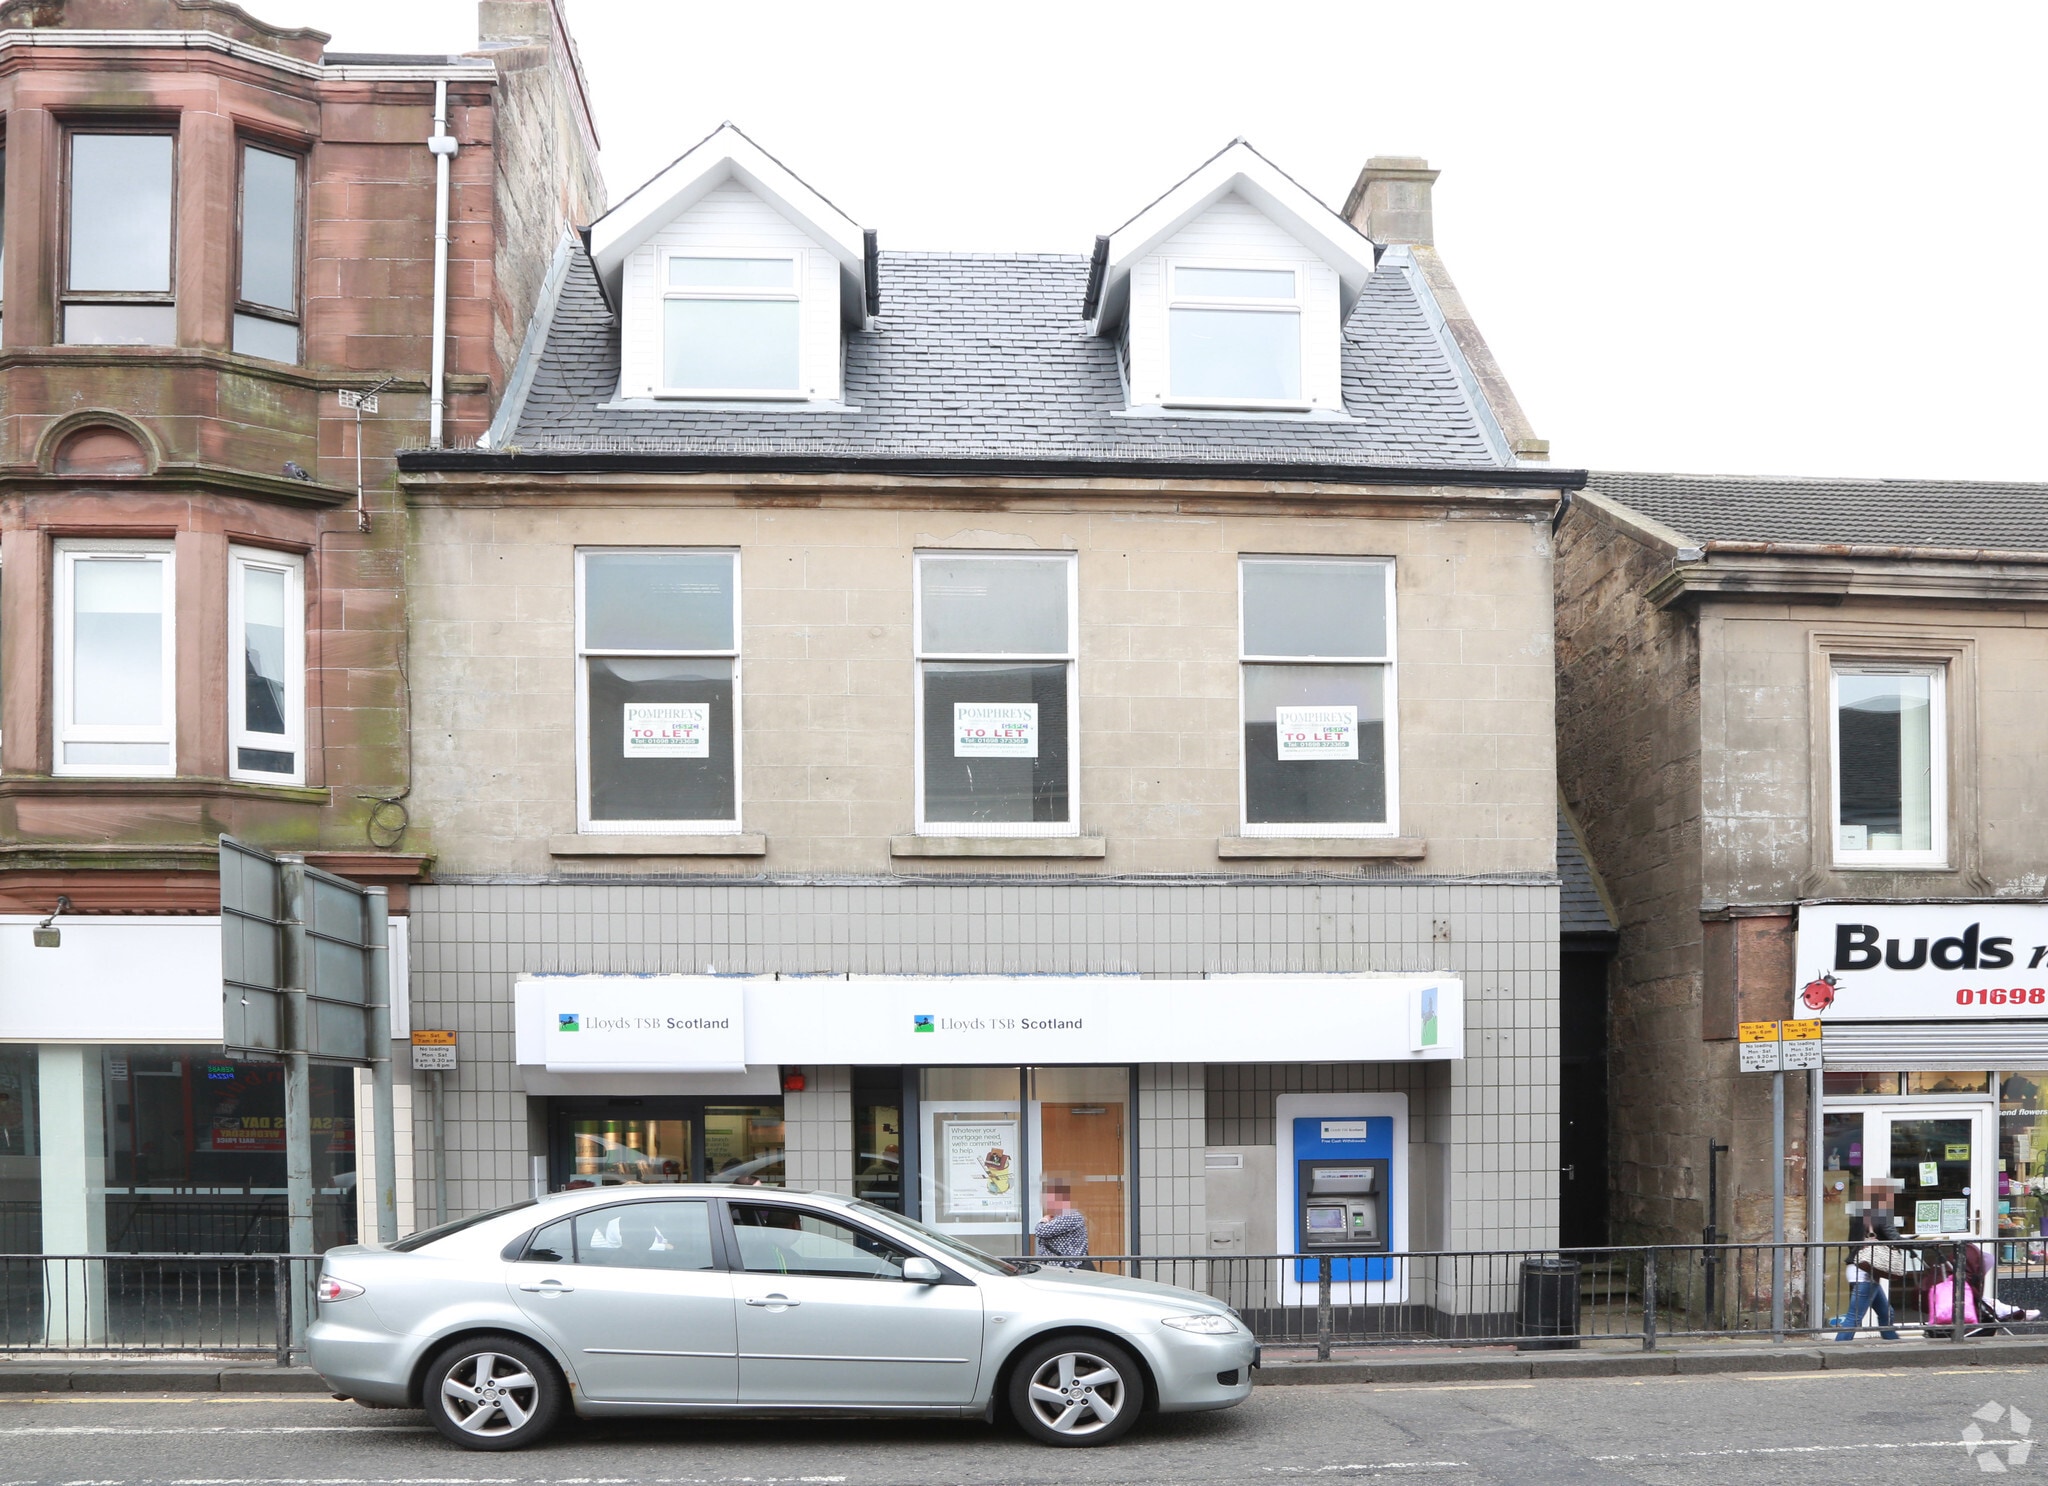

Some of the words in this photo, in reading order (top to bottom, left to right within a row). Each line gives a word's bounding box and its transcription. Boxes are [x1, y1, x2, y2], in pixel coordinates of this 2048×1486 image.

[628, 708, 702, 721] POMPHREYS
[958, 708, 1032, 721] POMPHREYS
[1280, 712, 1352, 724] POMPHREYS
[632, 730, 654, 738] TO
[662, 730, 693, 738] LET
[965, 729, 986, 737] TO
[1285, 733, 1306, 741] TO
[1834, 922, 2014, 970] Buds
[1956, 988, 2046, 1005] 01698
[586, 1017, 630, 1032] Lloyds
[634, 1018, 660, 1028] TSB
[666, 1018, 729, 1029] Scotland
[941, 1018, 986, 1032] Lloyds
[989, 1018, 1015, 1029] TSB
[1021, 1018, 1082, 1029] Scotland
